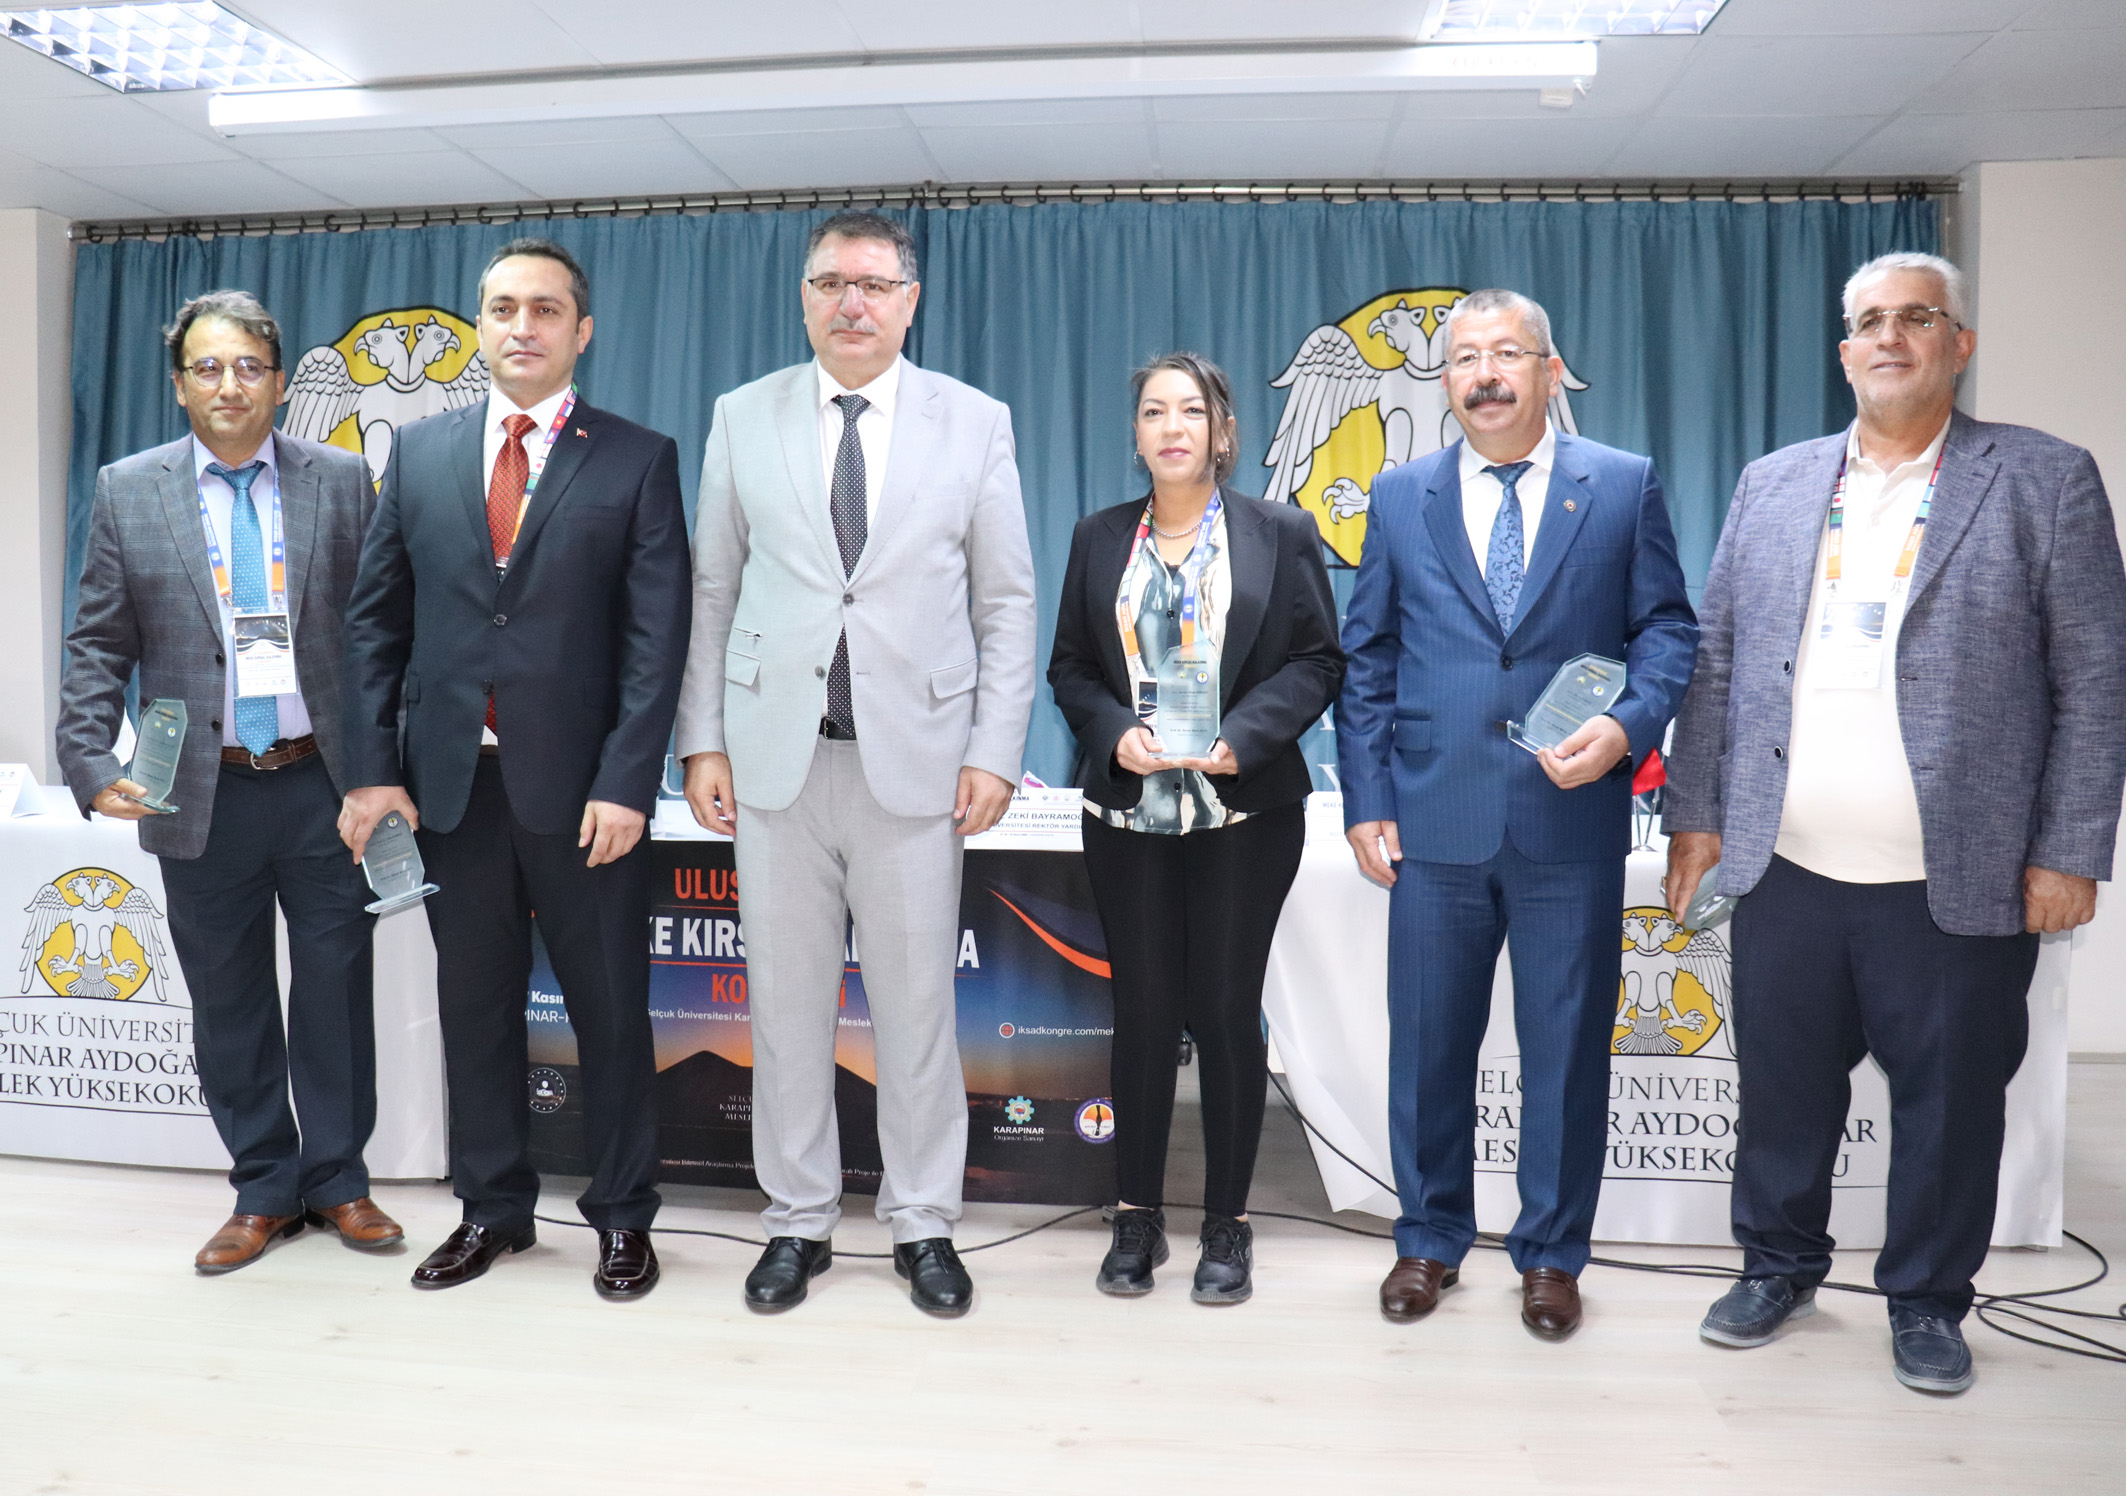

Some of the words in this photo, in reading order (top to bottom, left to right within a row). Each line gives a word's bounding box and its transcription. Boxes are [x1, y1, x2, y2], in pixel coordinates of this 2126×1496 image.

[677, 1008, 732, 1021] Üniversitesi
[838, 1017, 872, 1028] Meslek
[993, 1125, 1045, 1135] KARAPINAR
